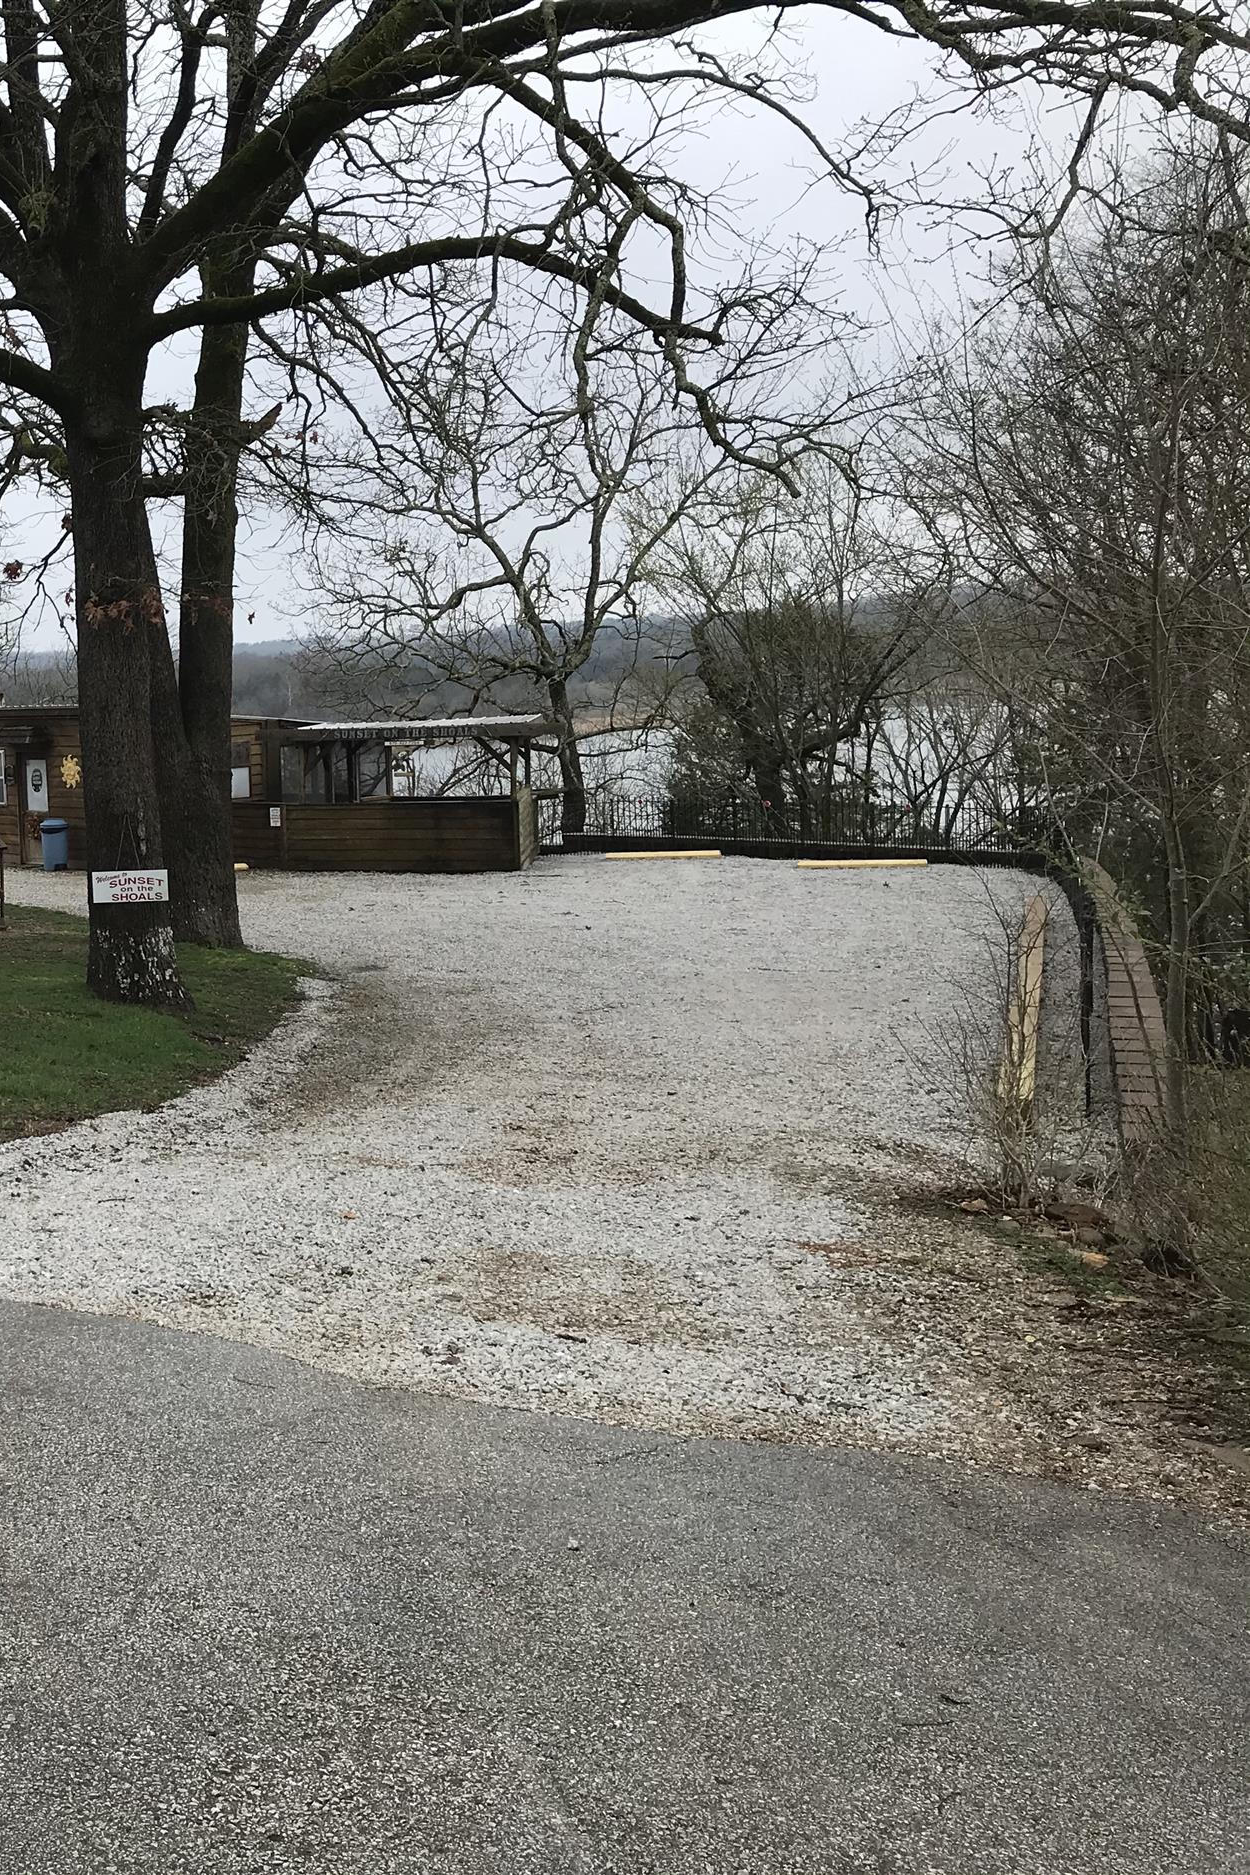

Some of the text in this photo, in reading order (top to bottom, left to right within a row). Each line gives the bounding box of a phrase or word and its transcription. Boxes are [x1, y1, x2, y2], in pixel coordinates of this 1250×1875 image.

[333, 726, 478, 739] SUNSET ON THE SHOALS
[109, 877, 164, 889] SUNSET
[111, 892, 163, 901] SHOALS
